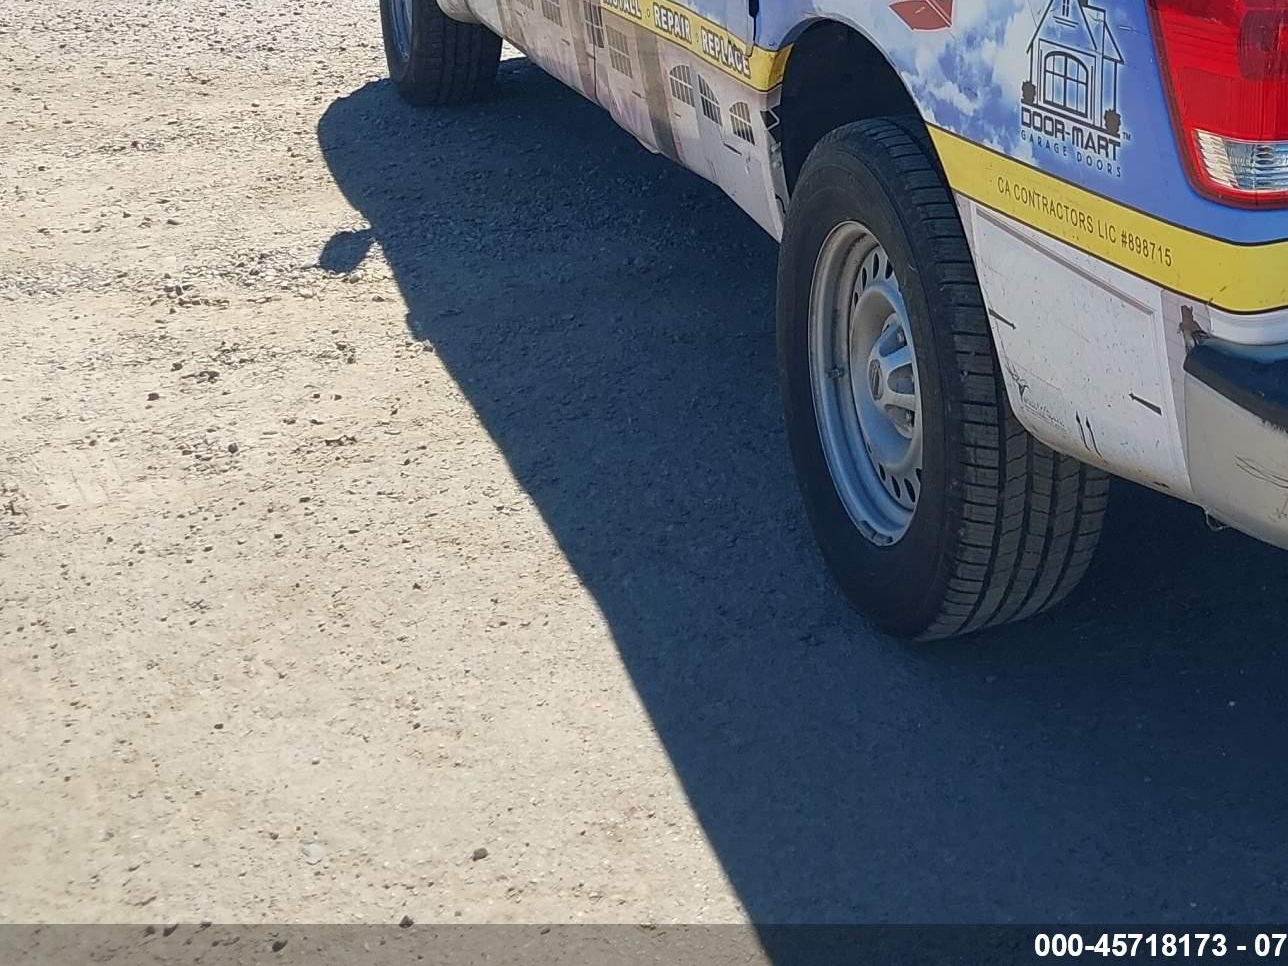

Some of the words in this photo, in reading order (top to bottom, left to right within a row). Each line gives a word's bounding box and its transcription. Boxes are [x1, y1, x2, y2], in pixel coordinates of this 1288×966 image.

[653, 1, 692, 45] REPAIR
[700, 25, 751, 80] REPLACE
[1021, 106, 1121, 161] DOOR-MART
[1021, 130, 1068, 156] GARAGE
[1077, 152, 1121, 178] DOORS
[997, 176, 1012, 196] CA
[1013, 184, 1094, 234] CONTRACTORS
[1097, 219, 1117, 244] LIC
[1121, 229, 1172, 266] #898715
